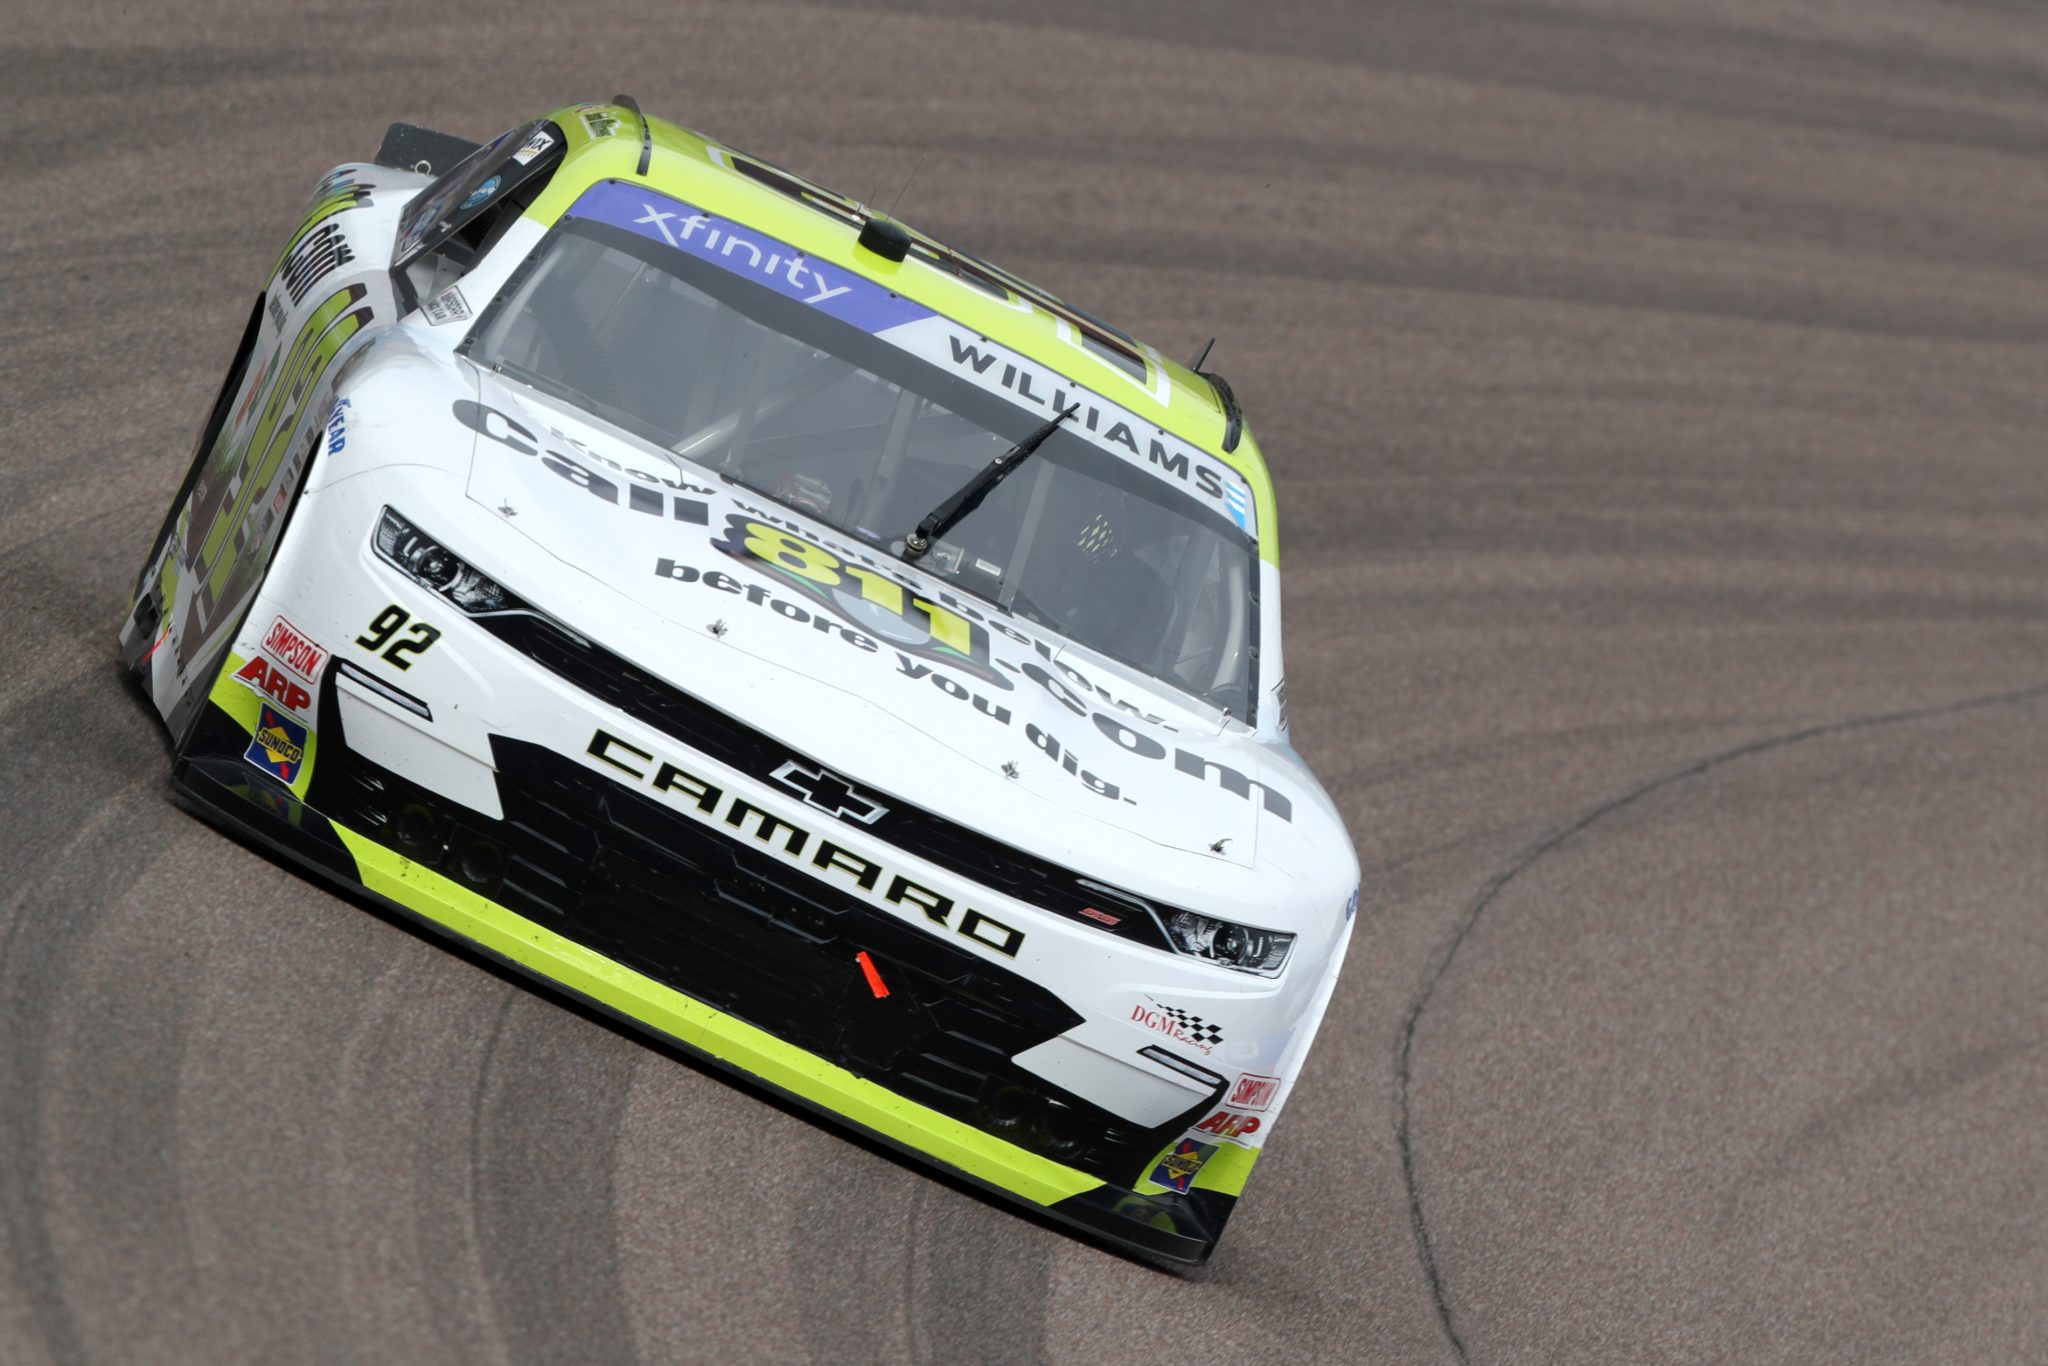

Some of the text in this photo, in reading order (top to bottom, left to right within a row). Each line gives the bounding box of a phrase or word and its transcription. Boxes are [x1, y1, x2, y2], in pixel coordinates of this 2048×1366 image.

[949, 334, 1224, 500] WILLIAMS
[550, 426, 717, 495] Know
[731, 498, 922, 590] what's
[236, 655, 312, 712] ARP
[265, 622, 322, 677] SIMPSON
[355, 604, 442, 672] 92
[655, 557, 1138, 806] before you dig.
[258, 730, 298, 763] SUNOCO
[585, 728, 1026, 959] CAMARO
